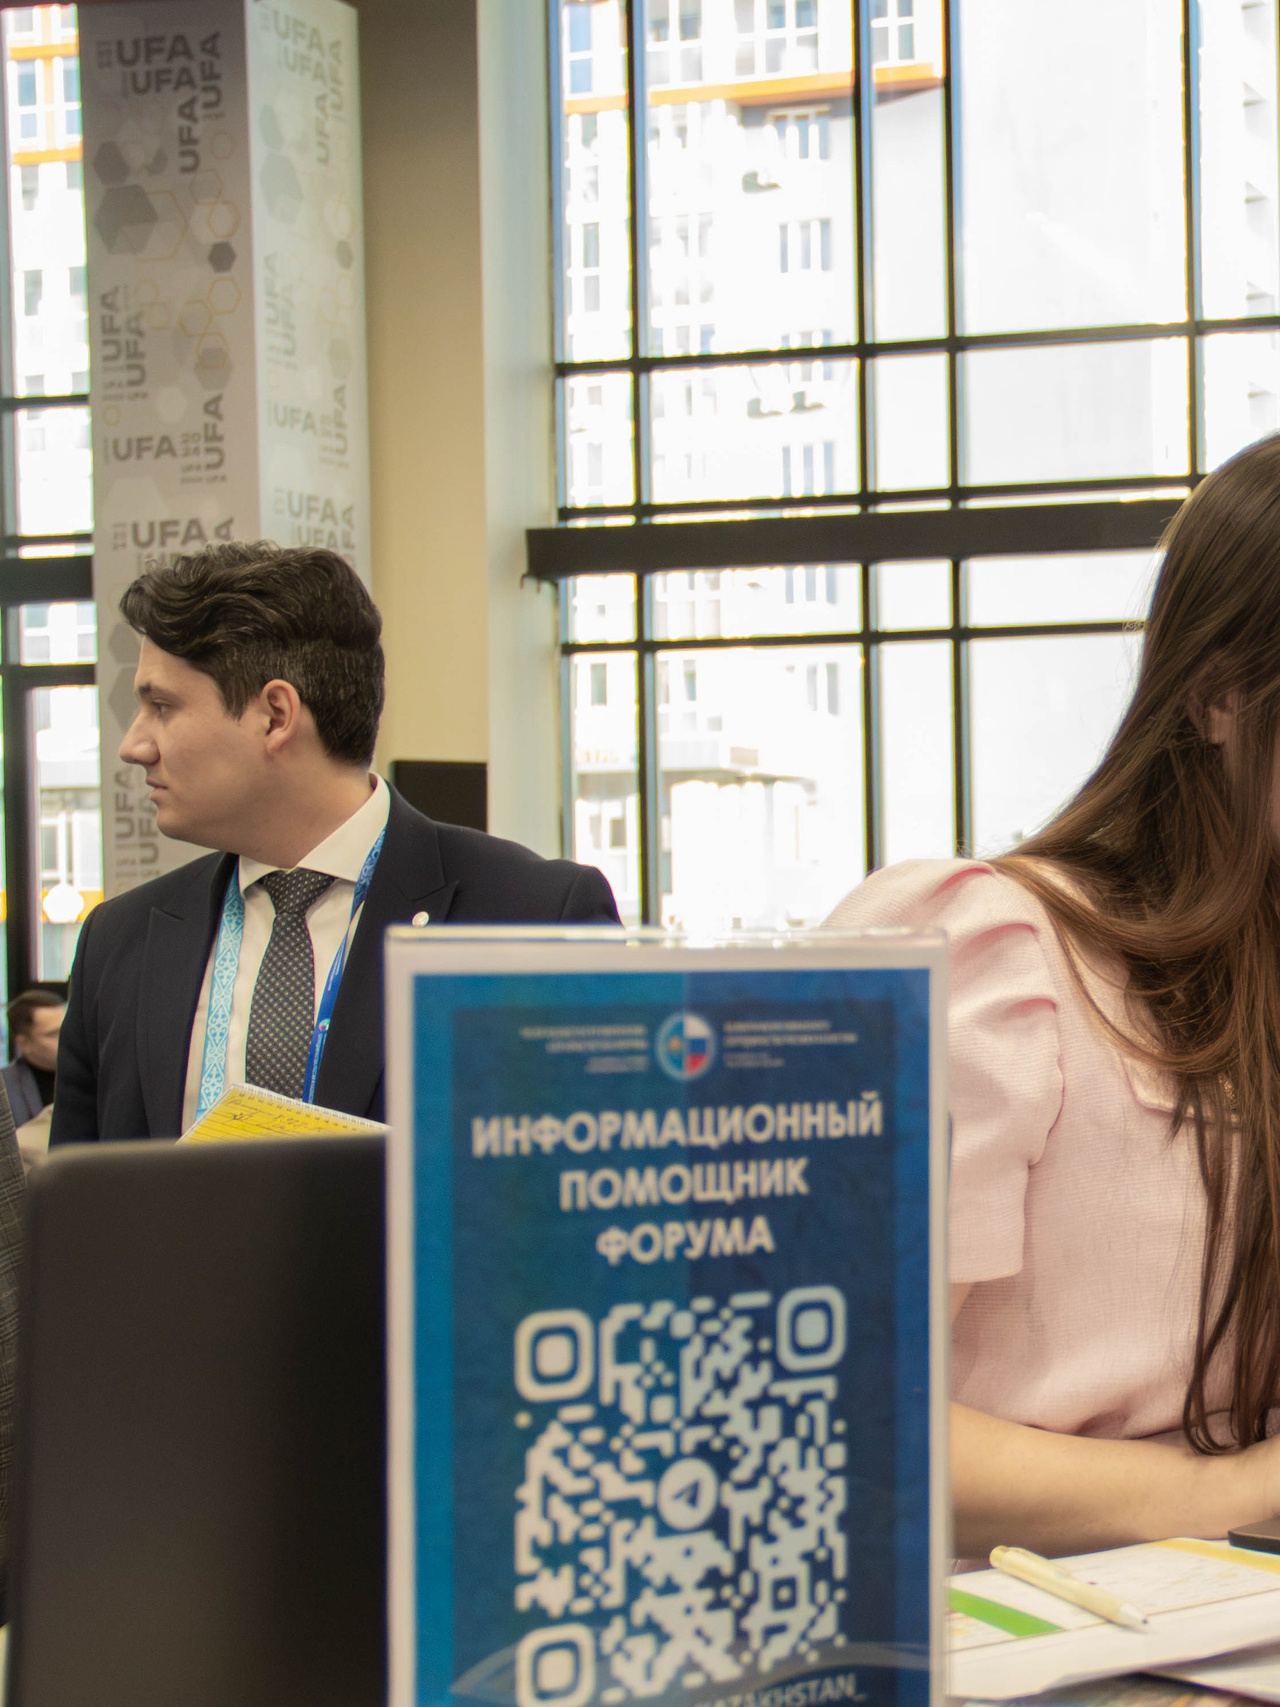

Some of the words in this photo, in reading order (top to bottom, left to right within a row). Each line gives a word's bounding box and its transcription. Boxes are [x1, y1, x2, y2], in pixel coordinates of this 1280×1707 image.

[116, 33, 195, 66] UFA
[203, 31, 222, 109] UFA
[129, 65, 197, 94] UFA
[178, 95, 199, 174] UFA
[101, 285, 121, 361] UFA
[125, 311, 146, 387] UFA
[112, 434, 177, 461] UFA
[204, 393, 225, 470] UFA
[132, 517, 207, 548] UFA
[287, 490, 337, 526] UFA
[471, 1091, 884, 1159] ИНФОРМАЦИОННЫЙ
[559, 1157, 810, 1213] ПОМОЩНИК
[596, 1215, 776, 1267] ФОРУМА
